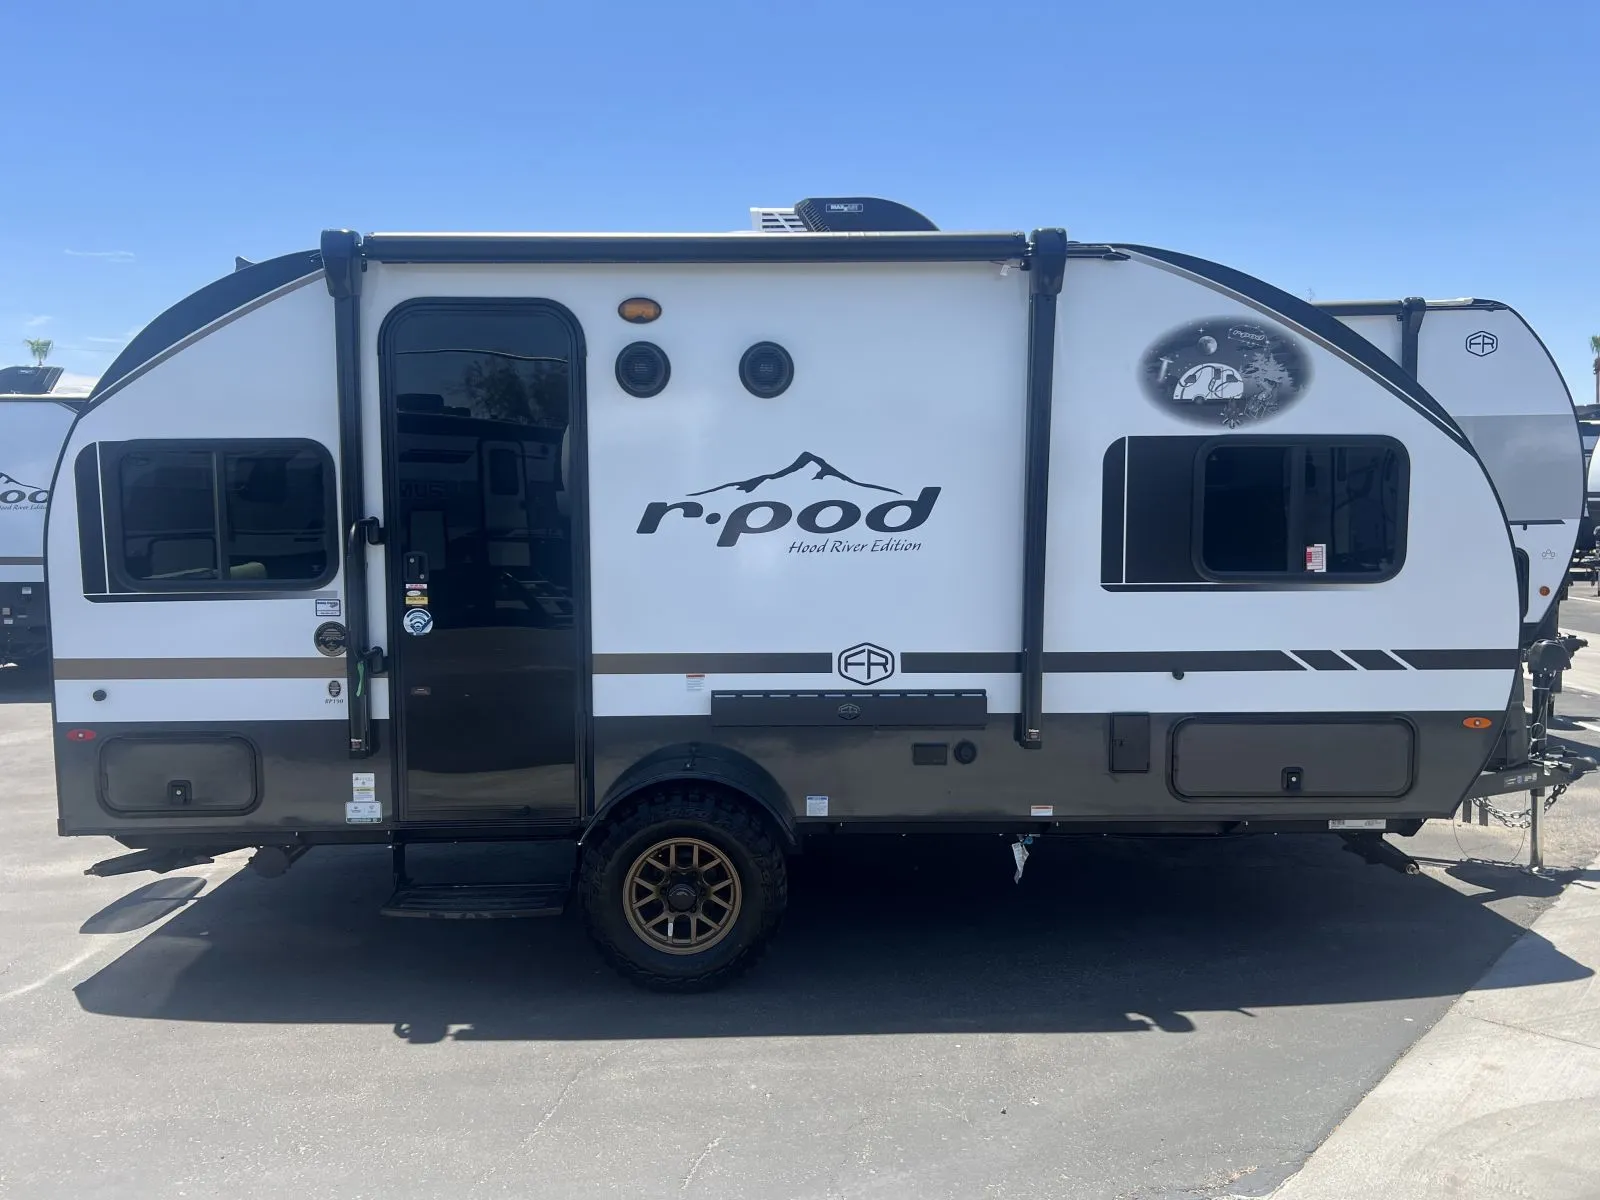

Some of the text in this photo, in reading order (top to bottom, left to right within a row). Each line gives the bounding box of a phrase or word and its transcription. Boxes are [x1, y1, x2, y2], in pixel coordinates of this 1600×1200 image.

[788, 537, 922, 554] Hood River Edition
